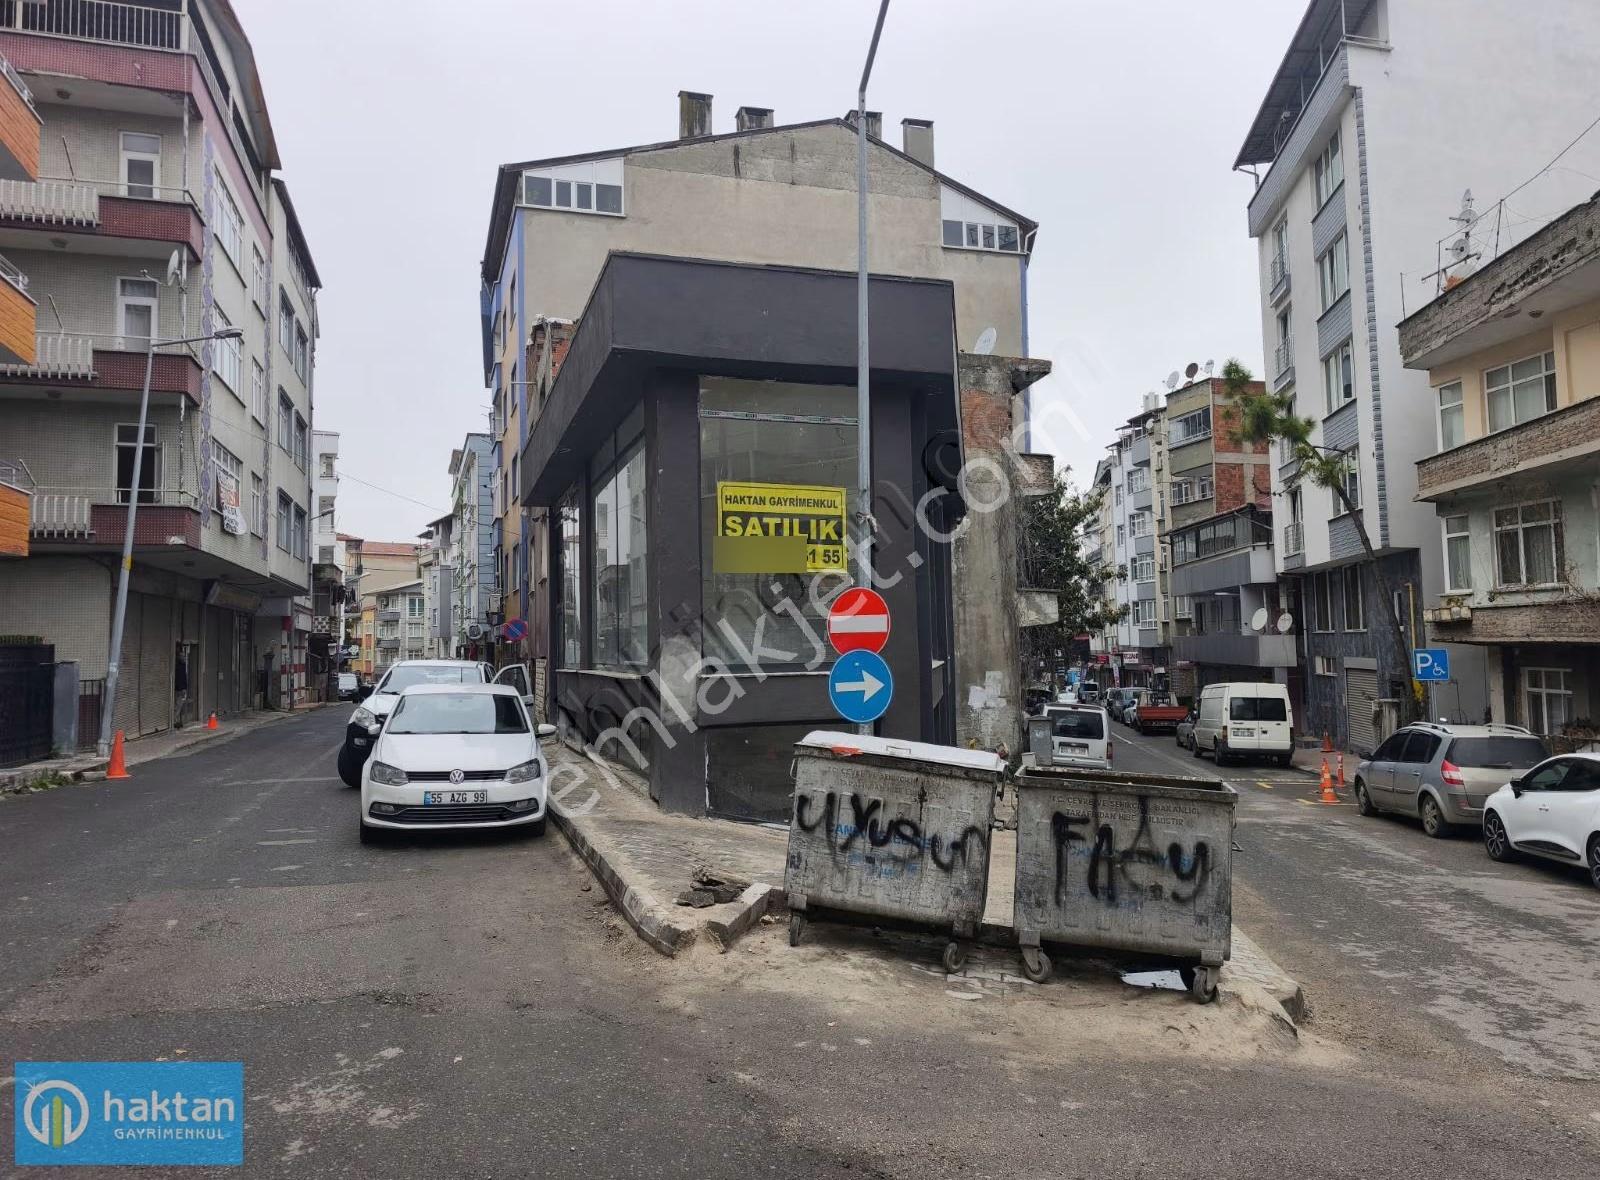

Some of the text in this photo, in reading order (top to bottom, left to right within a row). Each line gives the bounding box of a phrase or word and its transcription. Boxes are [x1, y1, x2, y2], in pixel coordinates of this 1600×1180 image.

[725, 495, 838, 509] HAKTAN GAYRİMENKUL
[725, 515, 839, 541] SATILIK
[823, 549, 840, 564] 55
[1416, 653, 1433, 675] P
[431, 792, 486, 803] 55 AZG 99
